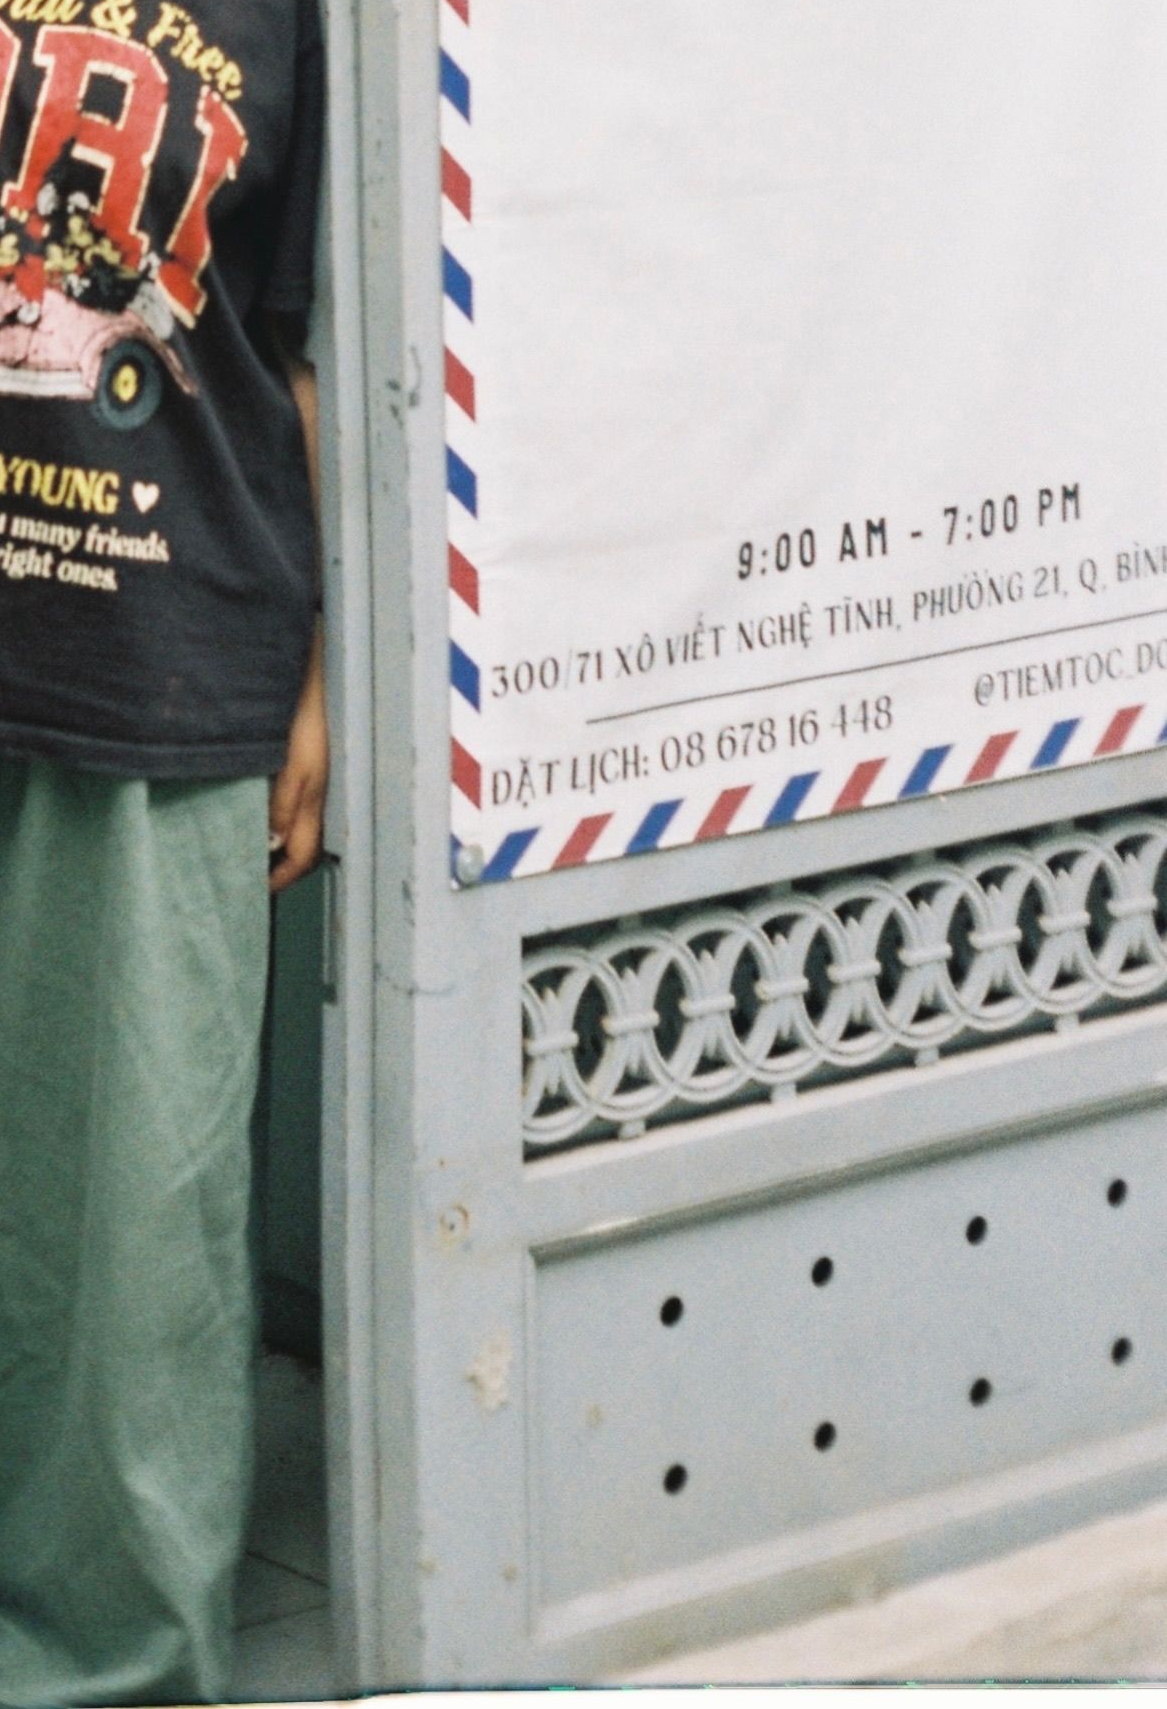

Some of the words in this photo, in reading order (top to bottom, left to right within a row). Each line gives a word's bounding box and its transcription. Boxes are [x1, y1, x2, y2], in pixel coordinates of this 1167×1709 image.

[11, 515, 82, 554] many
[738, 528, 815, 580] 9:00
[840, 517, 887, 561] AM
[943, 494, 1017, 544] 7:00
[1039, 483, 1080, 526] PM
[491, 649, 602, 698] 300/71
[616, 632, 655, 678] XÔ
[667, 611, 726, 665] VIẾT
[738, 602, 813, 651] NGHỆ
[913, 569, 1024, 621] PHƯỜNG
[571, 744, 649, 795] LỊCH:
[660, 731, 705, 772] 08
[717, 717, 777, 761] 678
[789, 709, 819, 747] 16
[832, 695, 893, 737] 448
